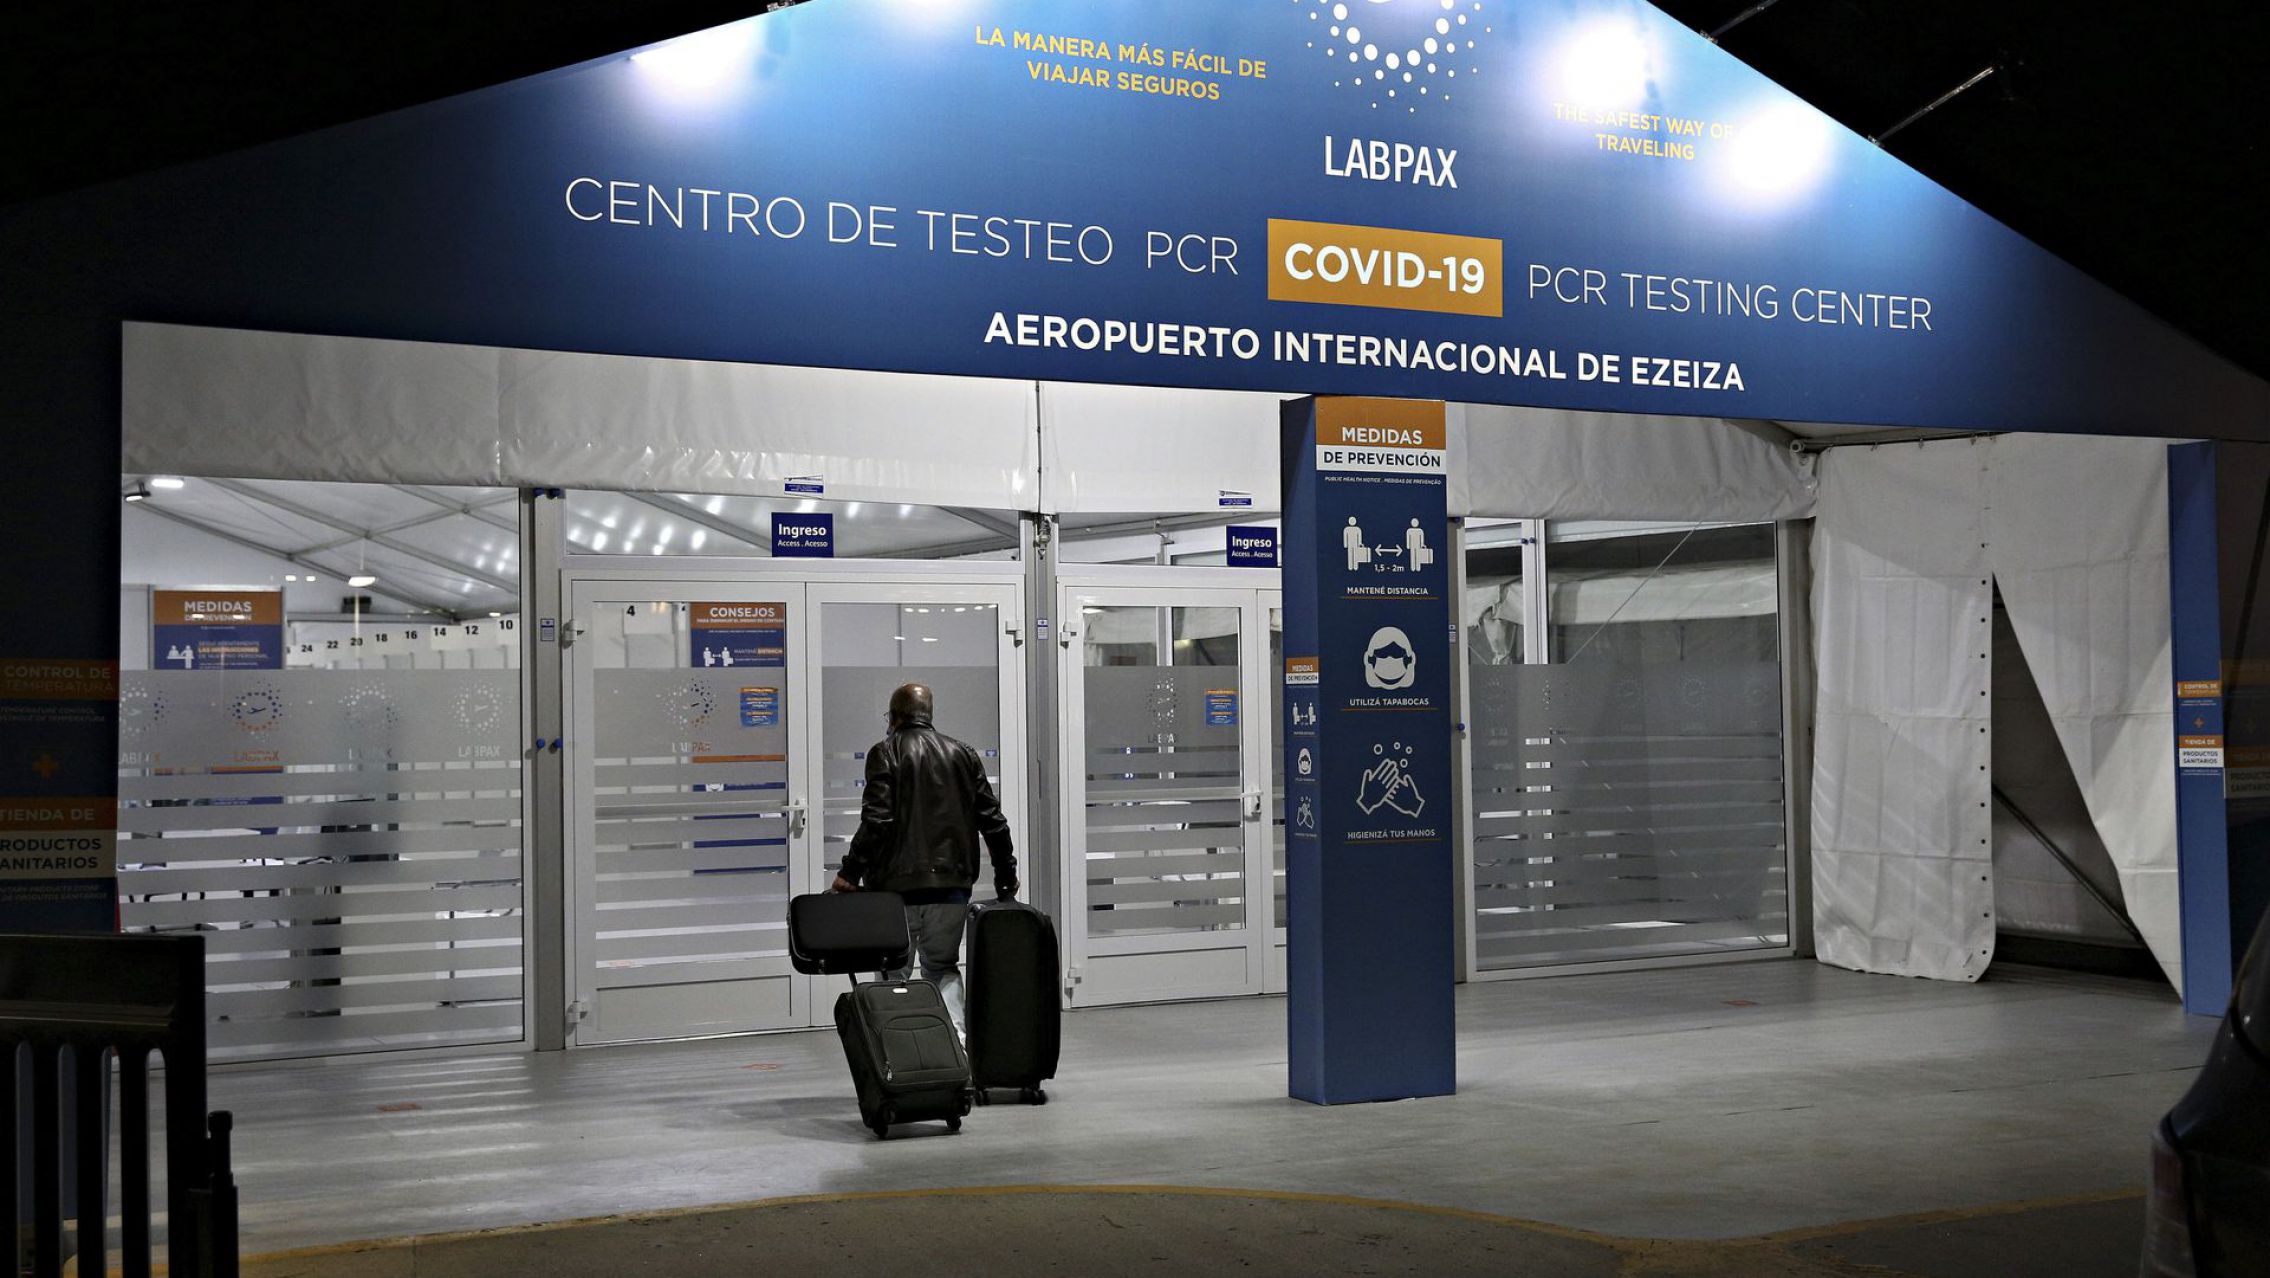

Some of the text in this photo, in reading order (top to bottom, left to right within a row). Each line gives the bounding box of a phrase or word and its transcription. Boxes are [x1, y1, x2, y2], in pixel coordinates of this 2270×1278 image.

[975, 25, 1267, 79] LA MANERA MÁS FÁCIL DE
[1027, 61, 1220, 100] VIAJAR SEGUROS
[1554, 103, 1735, 139] THE SAFEST WAY OF
[1596, 134, 1695, 160] TRAVELING
[1325, 135, 1458, 189] LABPAX
[565, 177, 1933, 331] CENTRO DE TESTEO PCR COVID-19 PCR TESTING CENTER
[983, 311, 1745, 391] AEROPUERTO INTERNACIONAL DE EZEIZA
[1342, 426, 1423, 445] MEDIDAS
[1323, 451, 1441, 467] DE PREVENCIÓN
[778, 523, 827, 539] Ingreso
[777, 539, 800, 547] Access
[1232, 535, 1272, 550] Ingreso
[1374, 564, 1385, 573] 1,5
[1392, 564, 1404, 572] 2m
[1347, 585, 1429, 595] MANTENÉ DISTANCIA
[184, 601, 252, 612] MEDIDAS
[626, 605, 636, 617] 4
[709, 607, 775, 618] CONSEJOS
[301, 644, 313, 652] 24
[327, 640, 339, 649] 22
[375, 633, 388, 643] 18
[404, 630, 418, 640] 16
[433, 627, 447, 637] 14
[465, 626, 479, 636] 12
[500, 620, 513, 630] 10
[4, 665, 112, 679] CONTROL DE
[6, 680, 114, 693] TEMPERATURA
[1349, 697, 1429, 706] UTILIZÁ TAPABOCAS
[71, 808, 96, 821] DE
[1347, 829, 1436, 839] HIGIENIZÁ TUS MANOS
